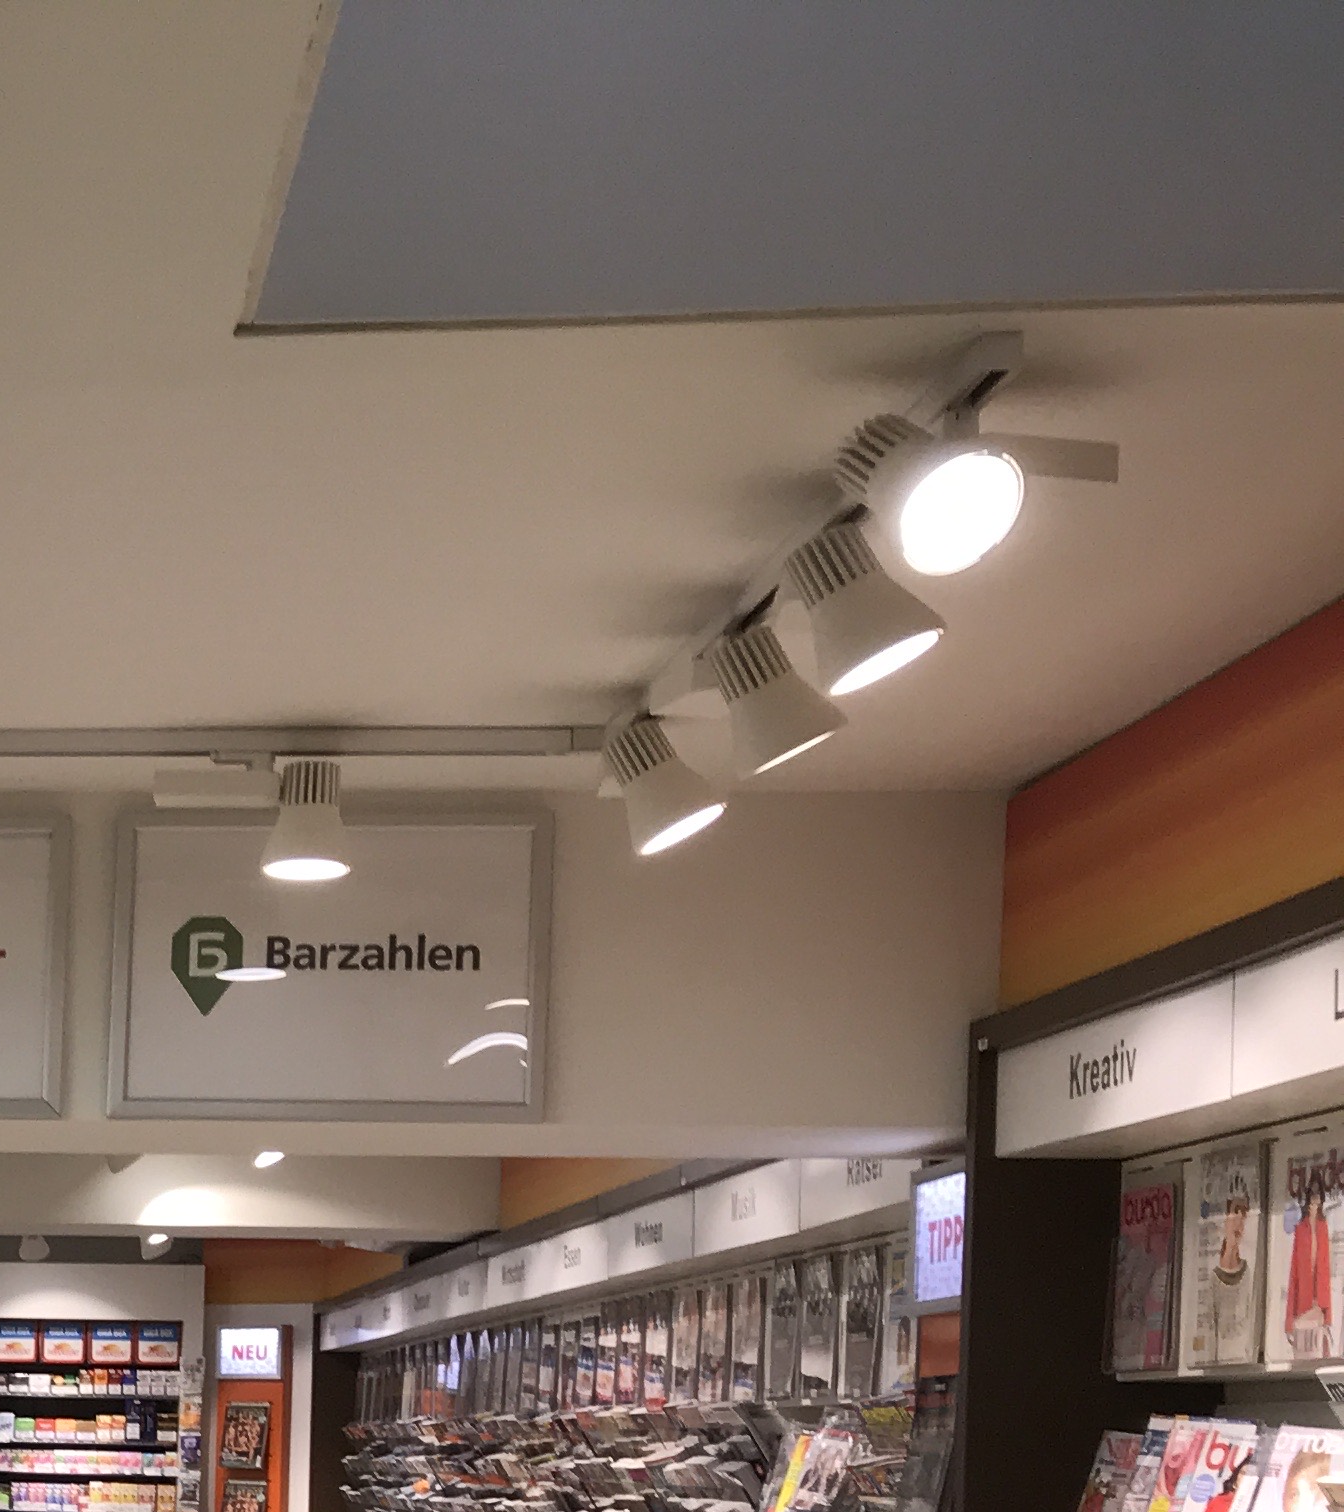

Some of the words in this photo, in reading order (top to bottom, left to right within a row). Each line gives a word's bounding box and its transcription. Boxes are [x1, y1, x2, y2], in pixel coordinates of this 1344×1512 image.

[265, 931, 482, 972] Barzahlen
[1069, 1038, 1138, 1100] Kreativ
[231, 1344, 268, 1361] NEU
